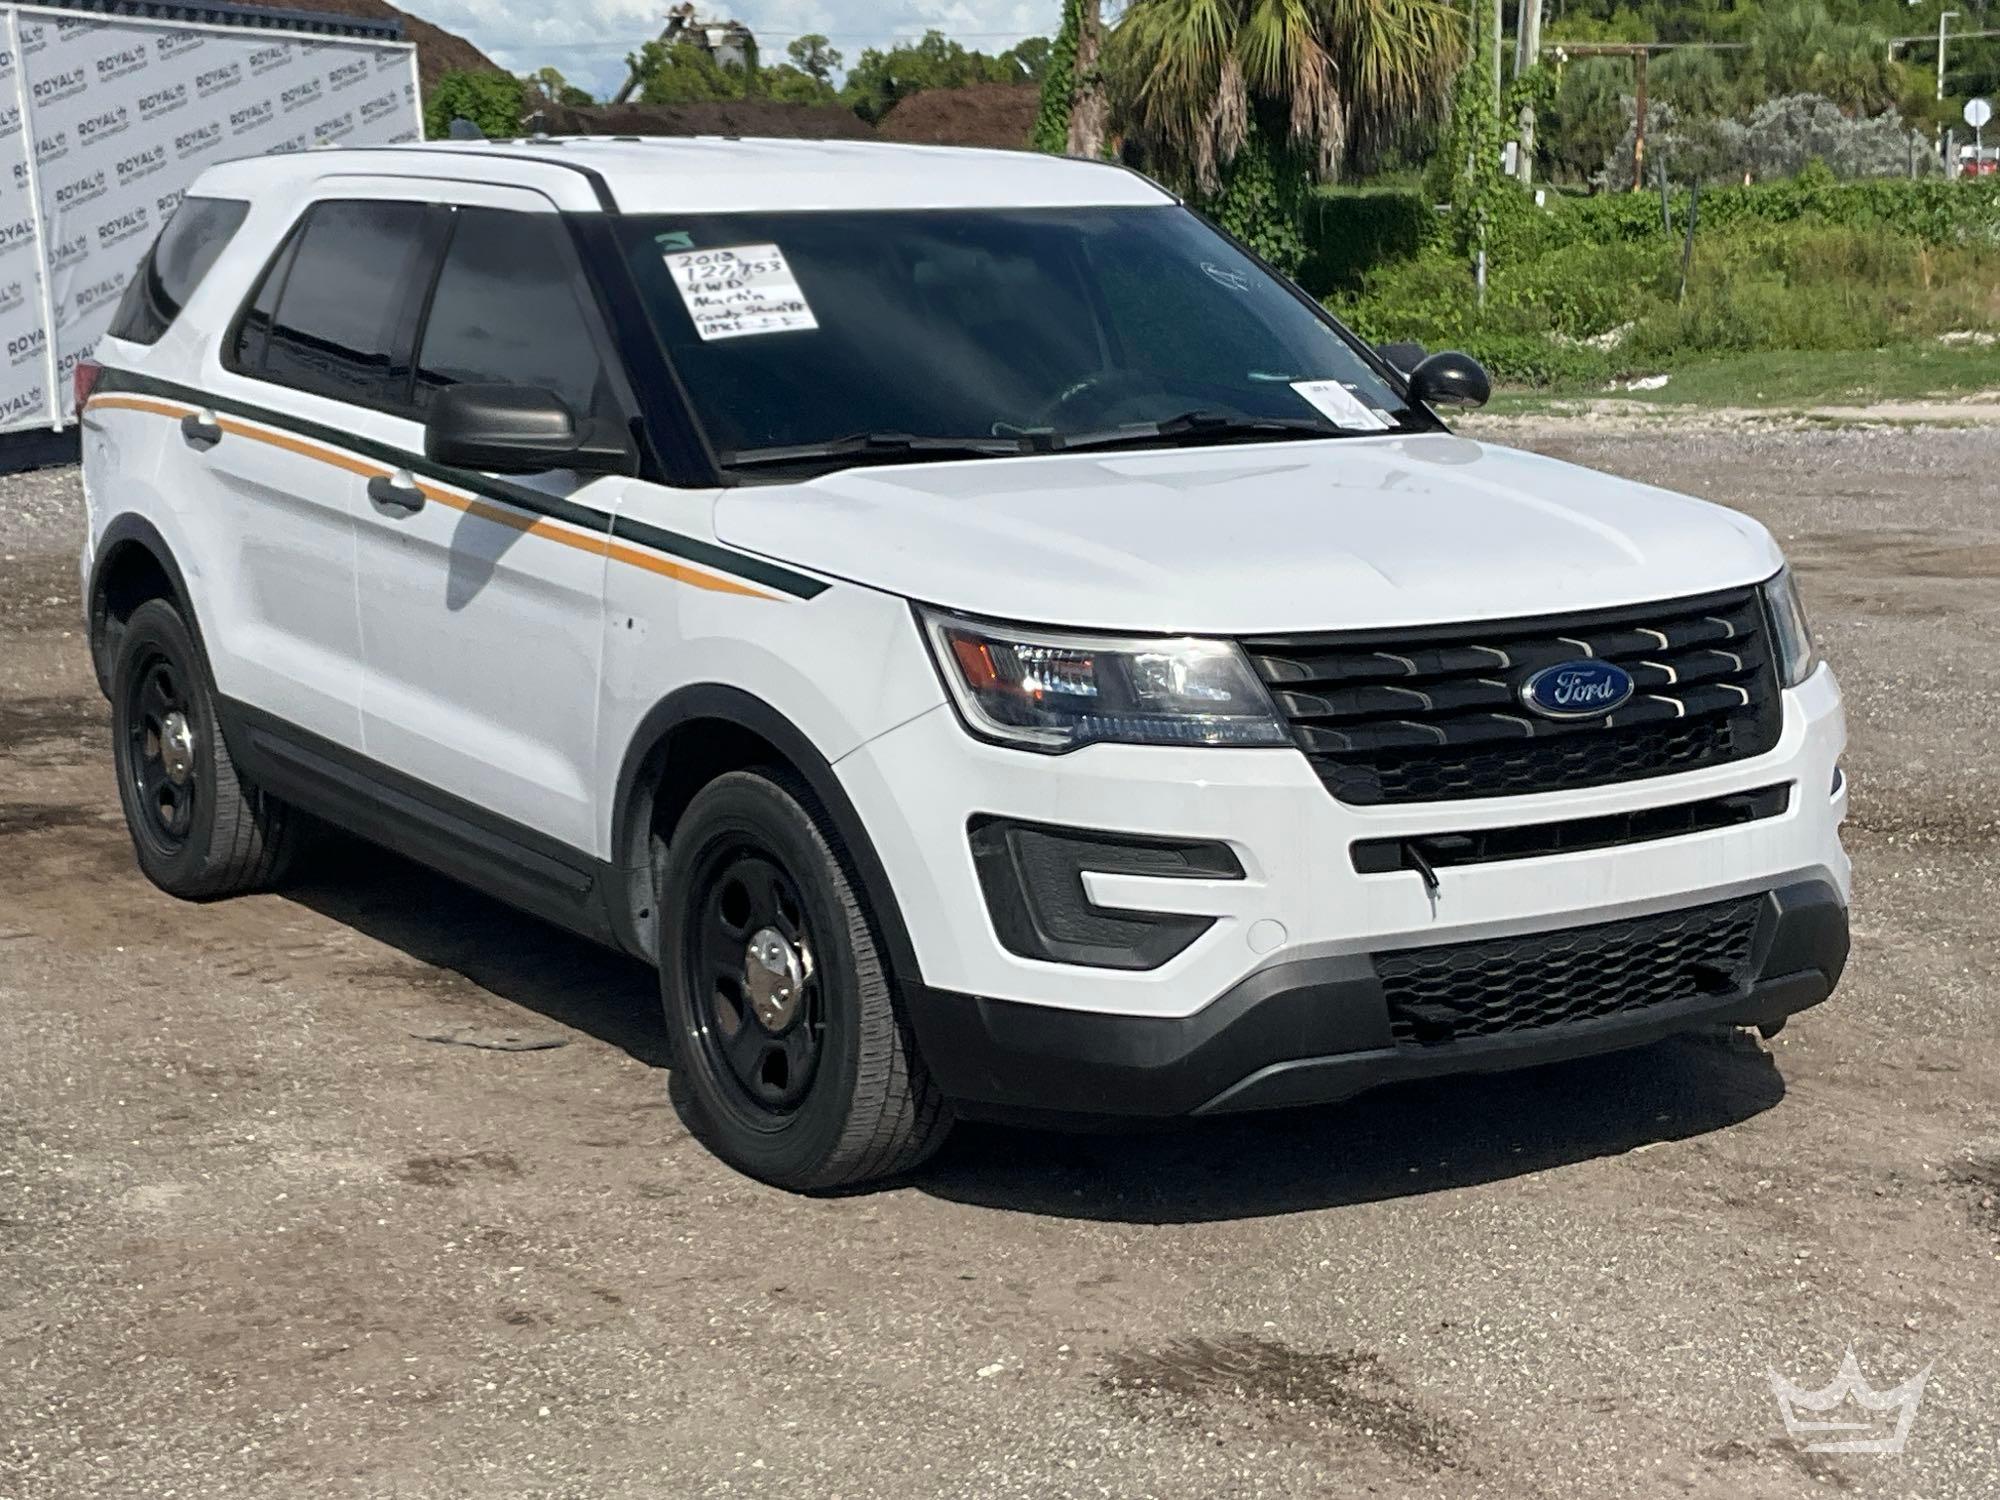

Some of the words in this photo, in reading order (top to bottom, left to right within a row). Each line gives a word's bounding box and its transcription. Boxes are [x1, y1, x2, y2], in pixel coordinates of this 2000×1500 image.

[96, 50, 136, 72] ROYAL
[249, 48, 283, 66] ROYAL
[33, 73, 74, 97] ROYAL
[195, 68, 231, 88] ROYAL
[329, 65, 359, 82] ROYAL
[139, 90, 176, 111] ROYAL
[281, 83, 313, 102] ROYAL
[78, 111, 118, 135] ROYAL
[230, 105, 264, 125] ROYAL
[175, 128, 211, 149] ROYAL
[116, 151, 155, 175] ROYAL
[57, 178, 96, 203] ROYAL
[0, 219, 33, 244] OYAL
[98, 212, 137, 238] ROYAL
[48, 241, 77, 265] OYAL
[76, 280, 115, 306] ROYAL
[8, 328, 46, 357] ROYA
[1554, 670, 1614, 704] Ford
